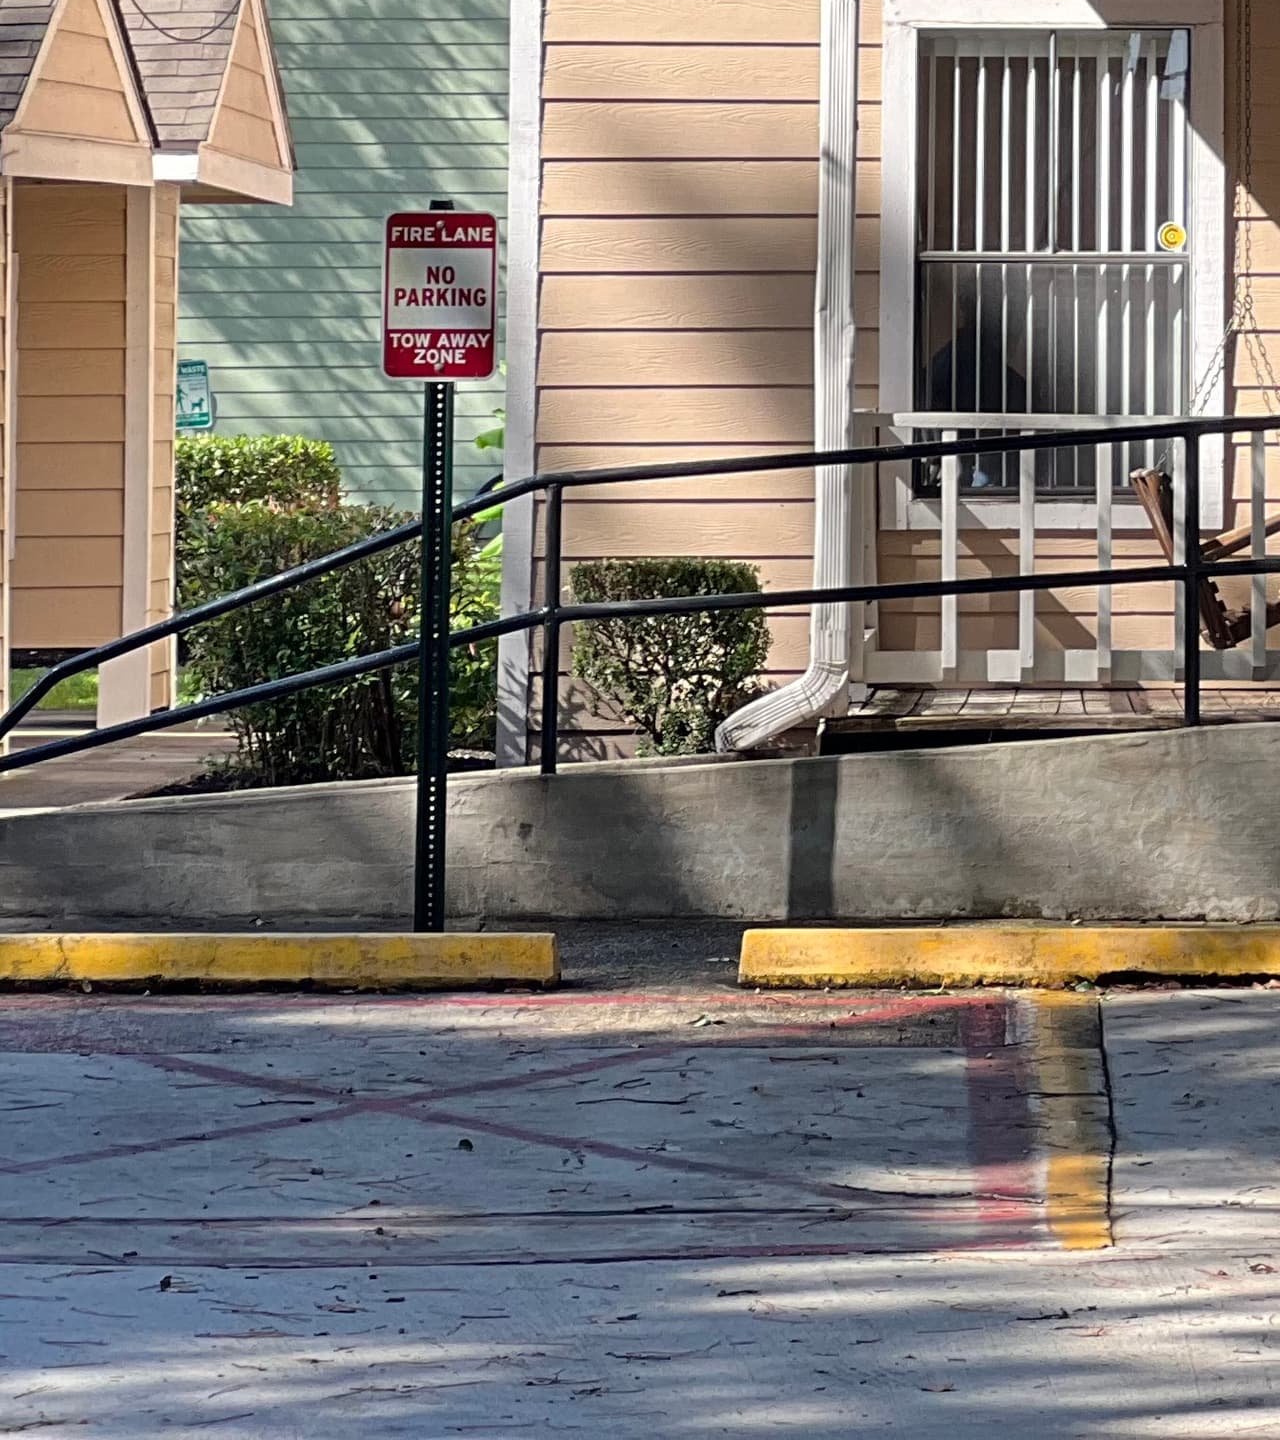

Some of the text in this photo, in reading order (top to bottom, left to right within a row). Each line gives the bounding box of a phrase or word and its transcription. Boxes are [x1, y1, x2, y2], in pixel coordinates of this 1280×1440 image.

[391, 226, 494, 243] FIRE LANE
[426, 265, 456, 285] NO
[393, 287, 487, 307] PARKING
[389, 332, 491, 348] TOW AWAY
[412, 348, 467, 364] ZONE
